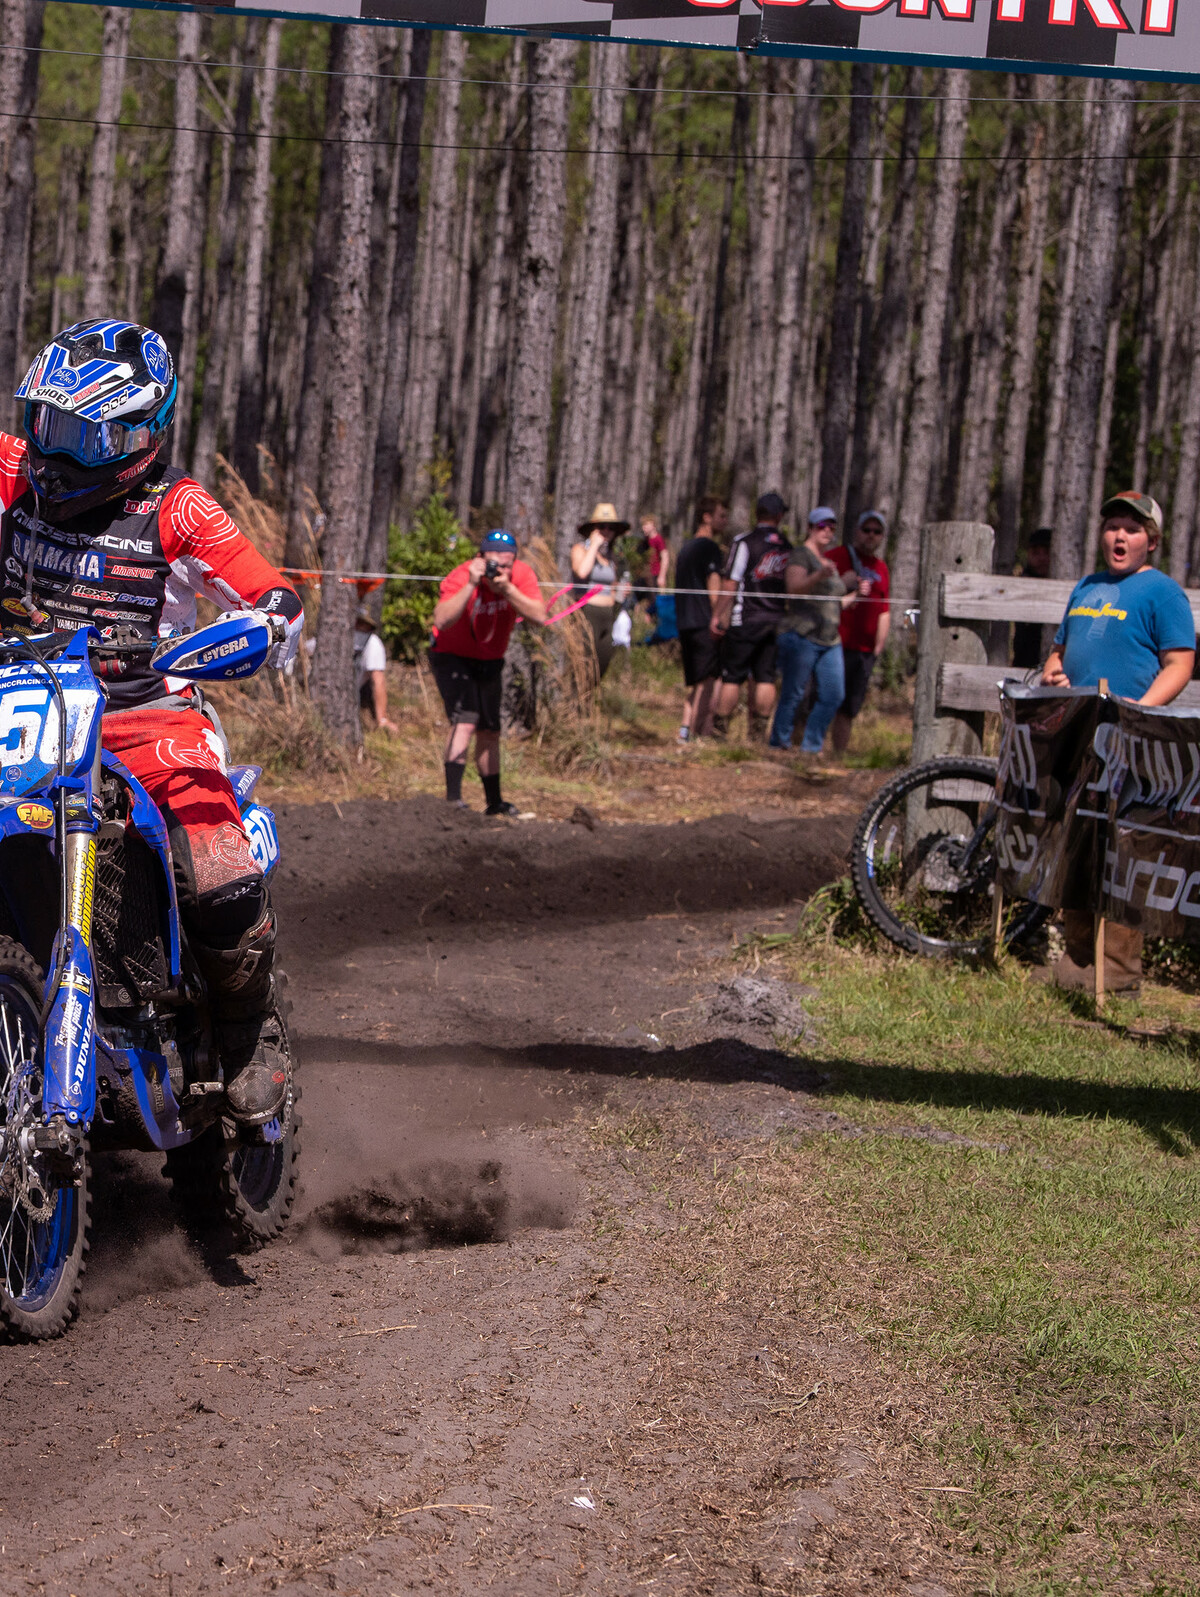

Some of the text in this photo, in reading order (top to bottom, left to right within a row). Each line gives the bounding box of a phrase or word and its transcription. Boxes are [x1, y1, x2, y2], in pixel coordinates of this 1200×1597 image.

[34, 388, 70, 406] SHOEI
[23, 538, 100, 579] YAMAHA
[202, 636, 249, 663] CYCRA
[19, 806, 54, 823] FMF
[75, 1000, 93, 1082] DUNLOP
